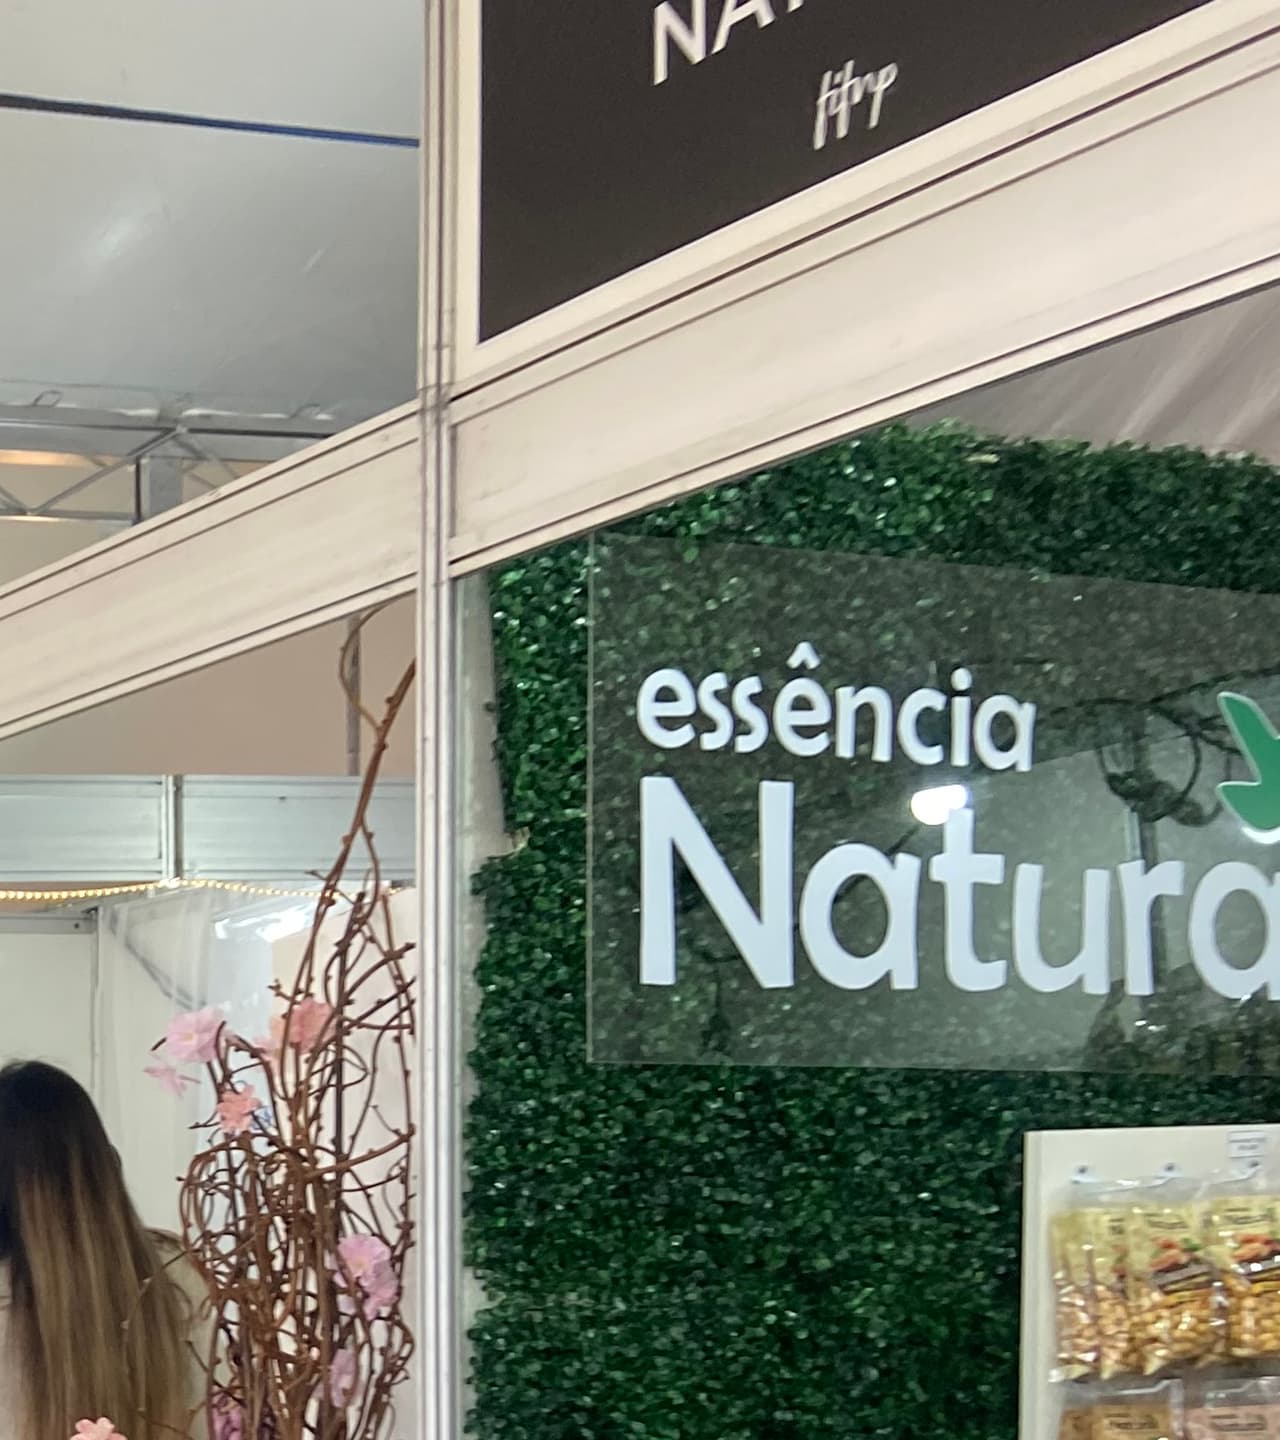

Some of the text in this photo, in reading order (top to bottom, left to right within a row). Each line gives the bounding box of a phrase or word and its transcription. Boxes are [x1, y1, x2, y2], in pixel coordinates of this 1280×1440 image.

[652, 0, 803, 86] NA
[637, 641, 1037, 772] essência
[639, 775, 1280, 1002] Natura
